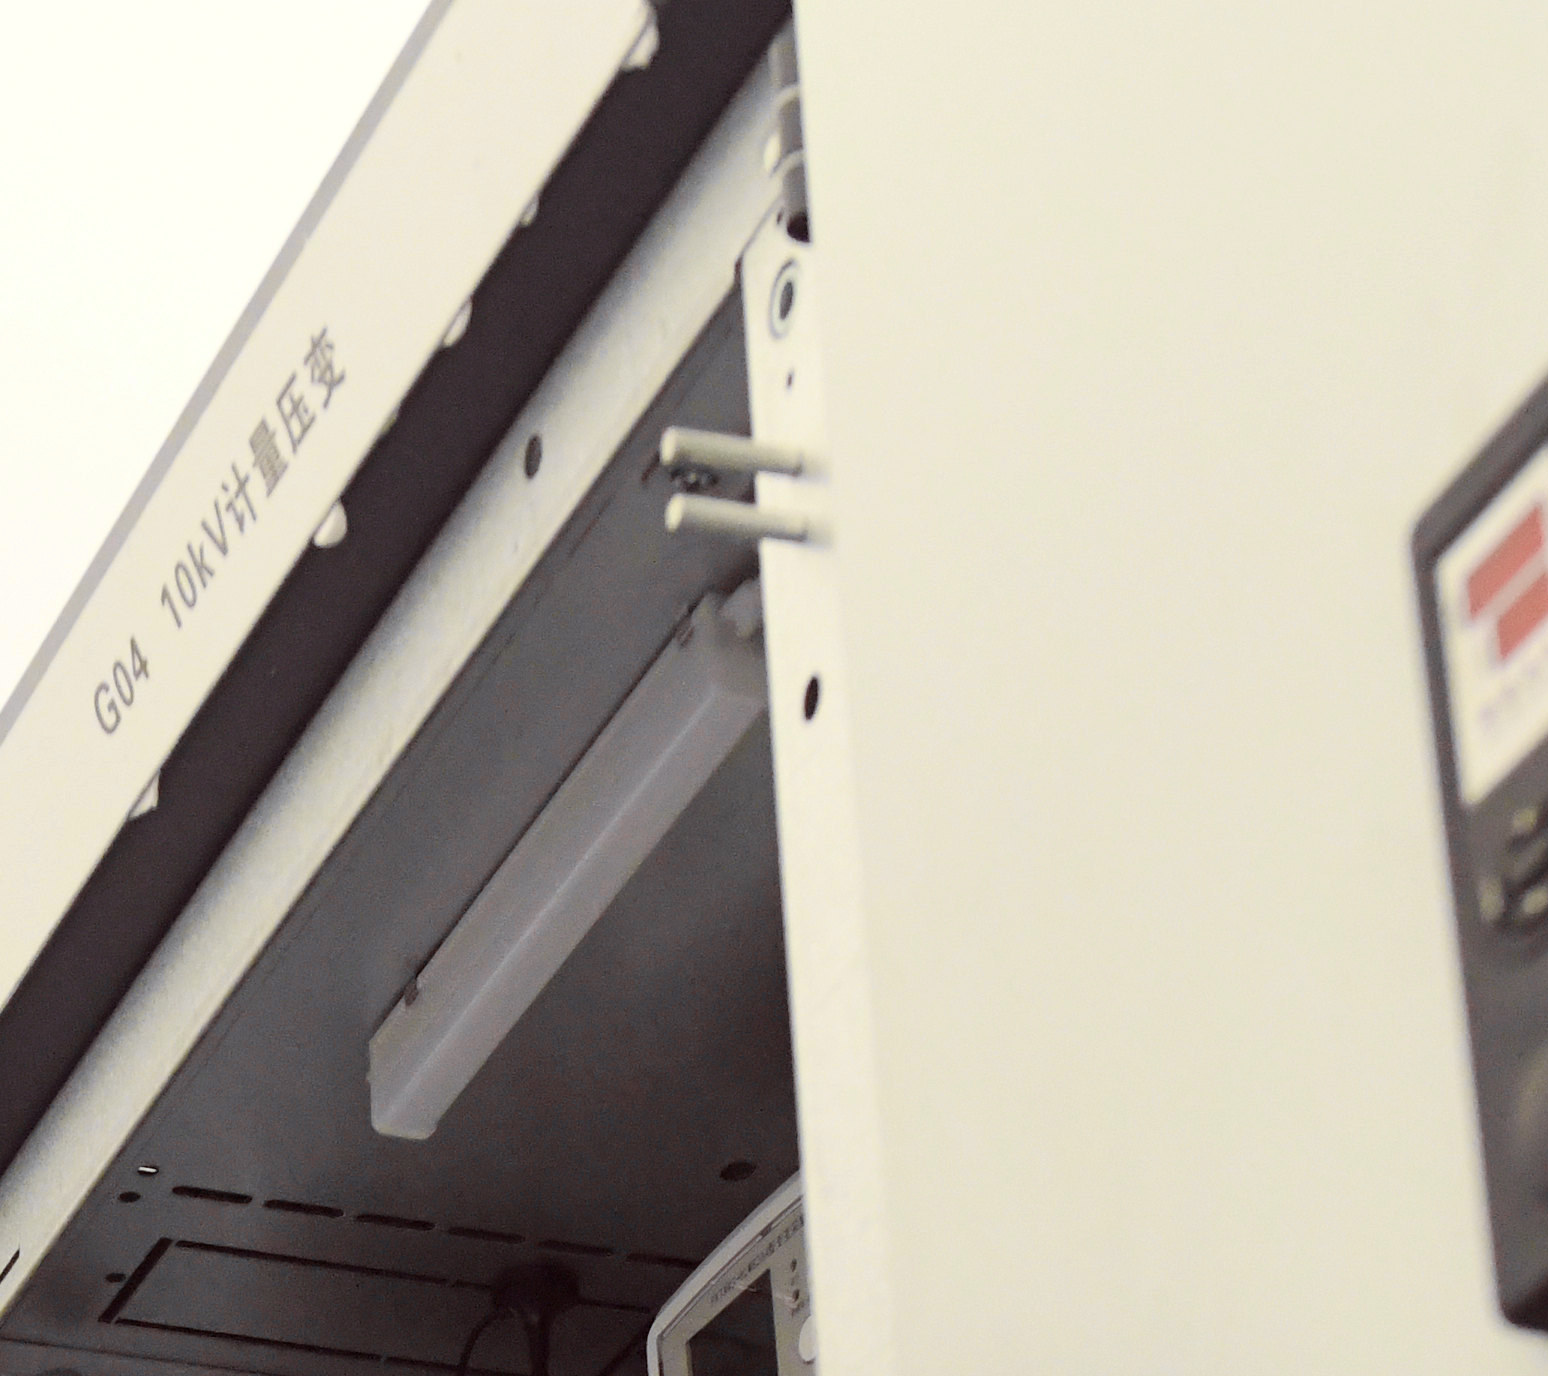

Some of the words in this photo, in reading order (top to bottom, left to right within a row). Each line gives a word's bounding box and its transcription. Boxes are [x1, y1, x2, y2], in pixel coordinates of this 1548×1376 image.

[94, 636, 149, 734] G04
[161, 326, 345, 629] 10kV计量压变
